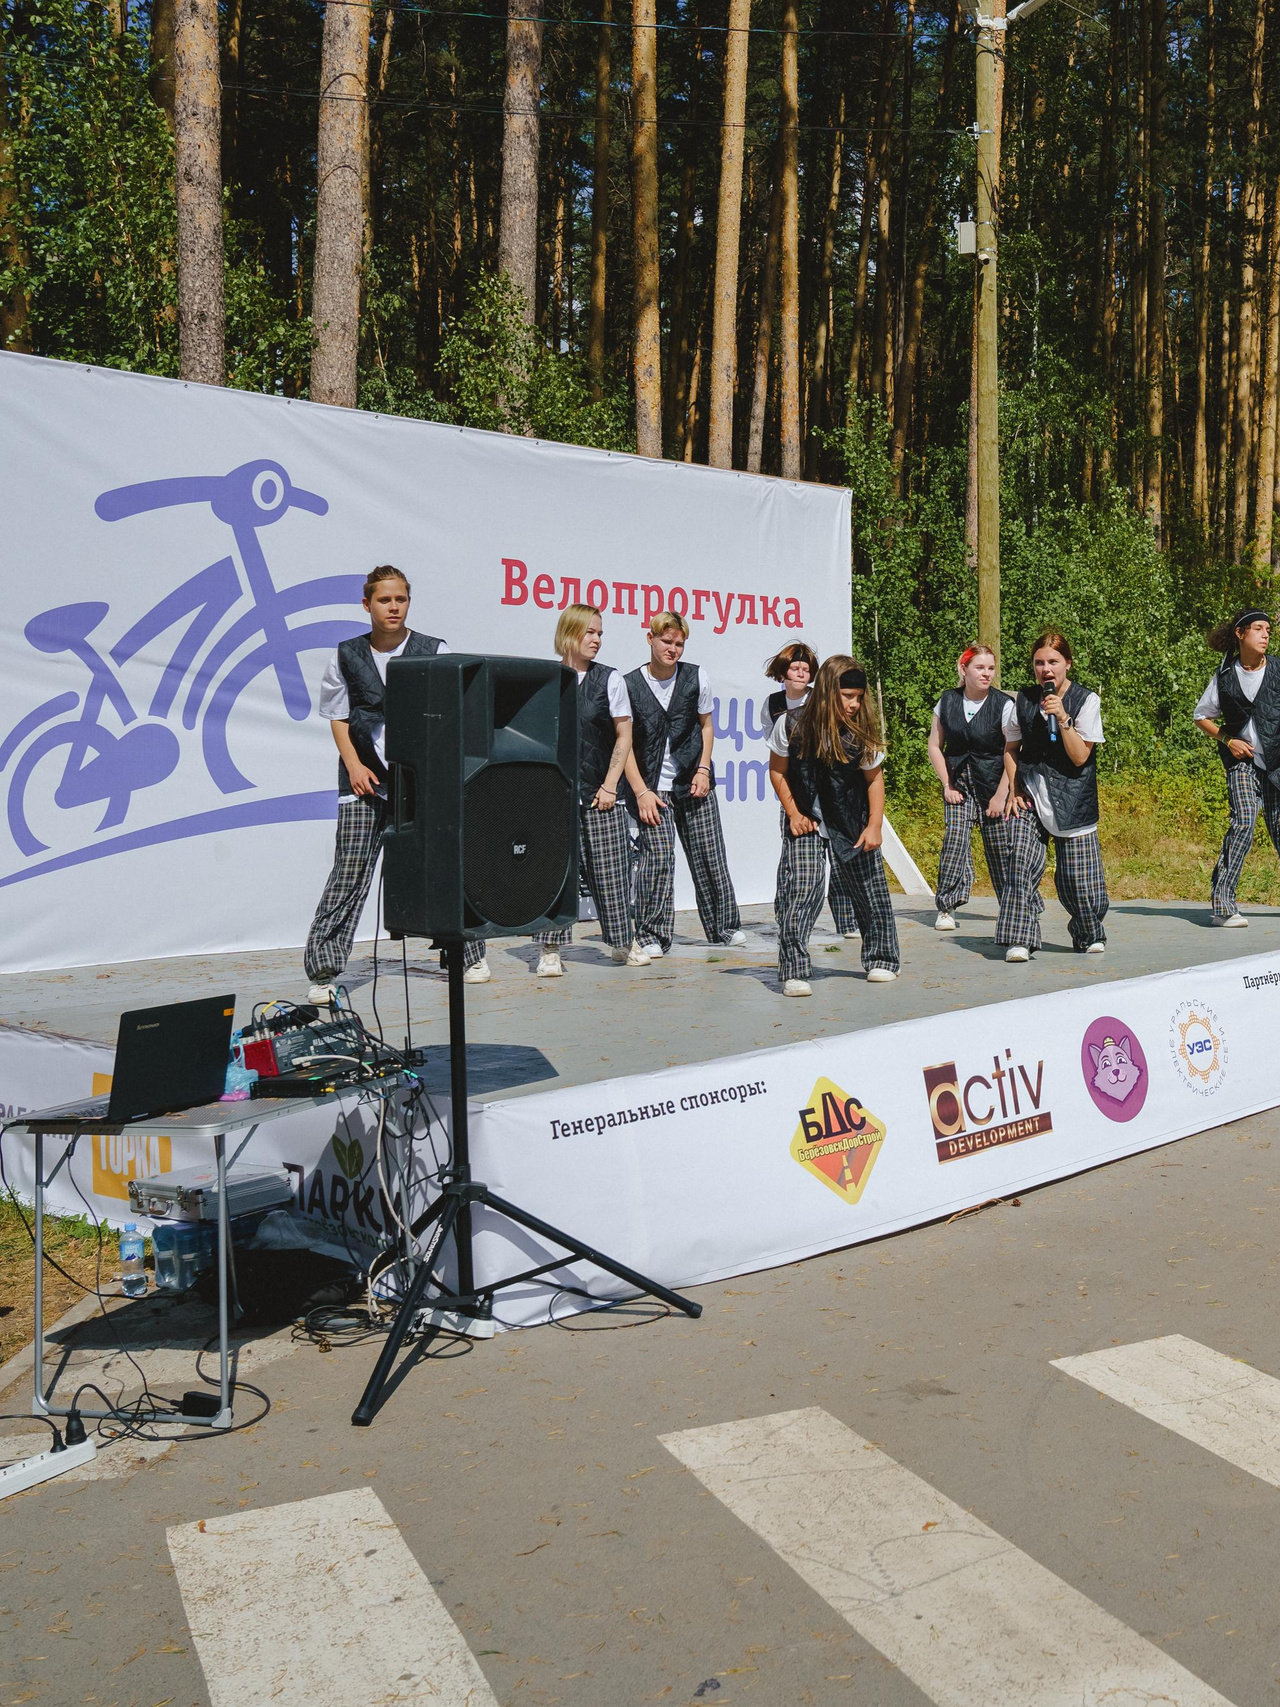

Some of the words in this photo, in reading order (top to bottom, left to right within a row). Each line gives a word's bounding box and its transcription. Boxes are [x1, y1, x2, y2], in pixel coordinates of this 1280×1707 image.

[501, 557, 804, 635] Велопрогулка
[513, 844, 527, 855] RCF
[1169, 998, 1219, 1033] УРАЛЬСКИЕ
[1168, 1038, 1227, 1097] ЭЛЕКТРИЧЕСКИЕ
[1186, 1038, 1213, 1056] УЭС
[1218, 1026, 1229, 1064] СЕТИ
[550, 1099, 676, 1140] Генеральные
[680, 1080, 767, 1111] спонсоры:
[929, 1048, 1044, 1137] activ
[798, 1091, 867, 1143] БДС
[949, 1117, 1040, 1156] DEVELOPMENT
